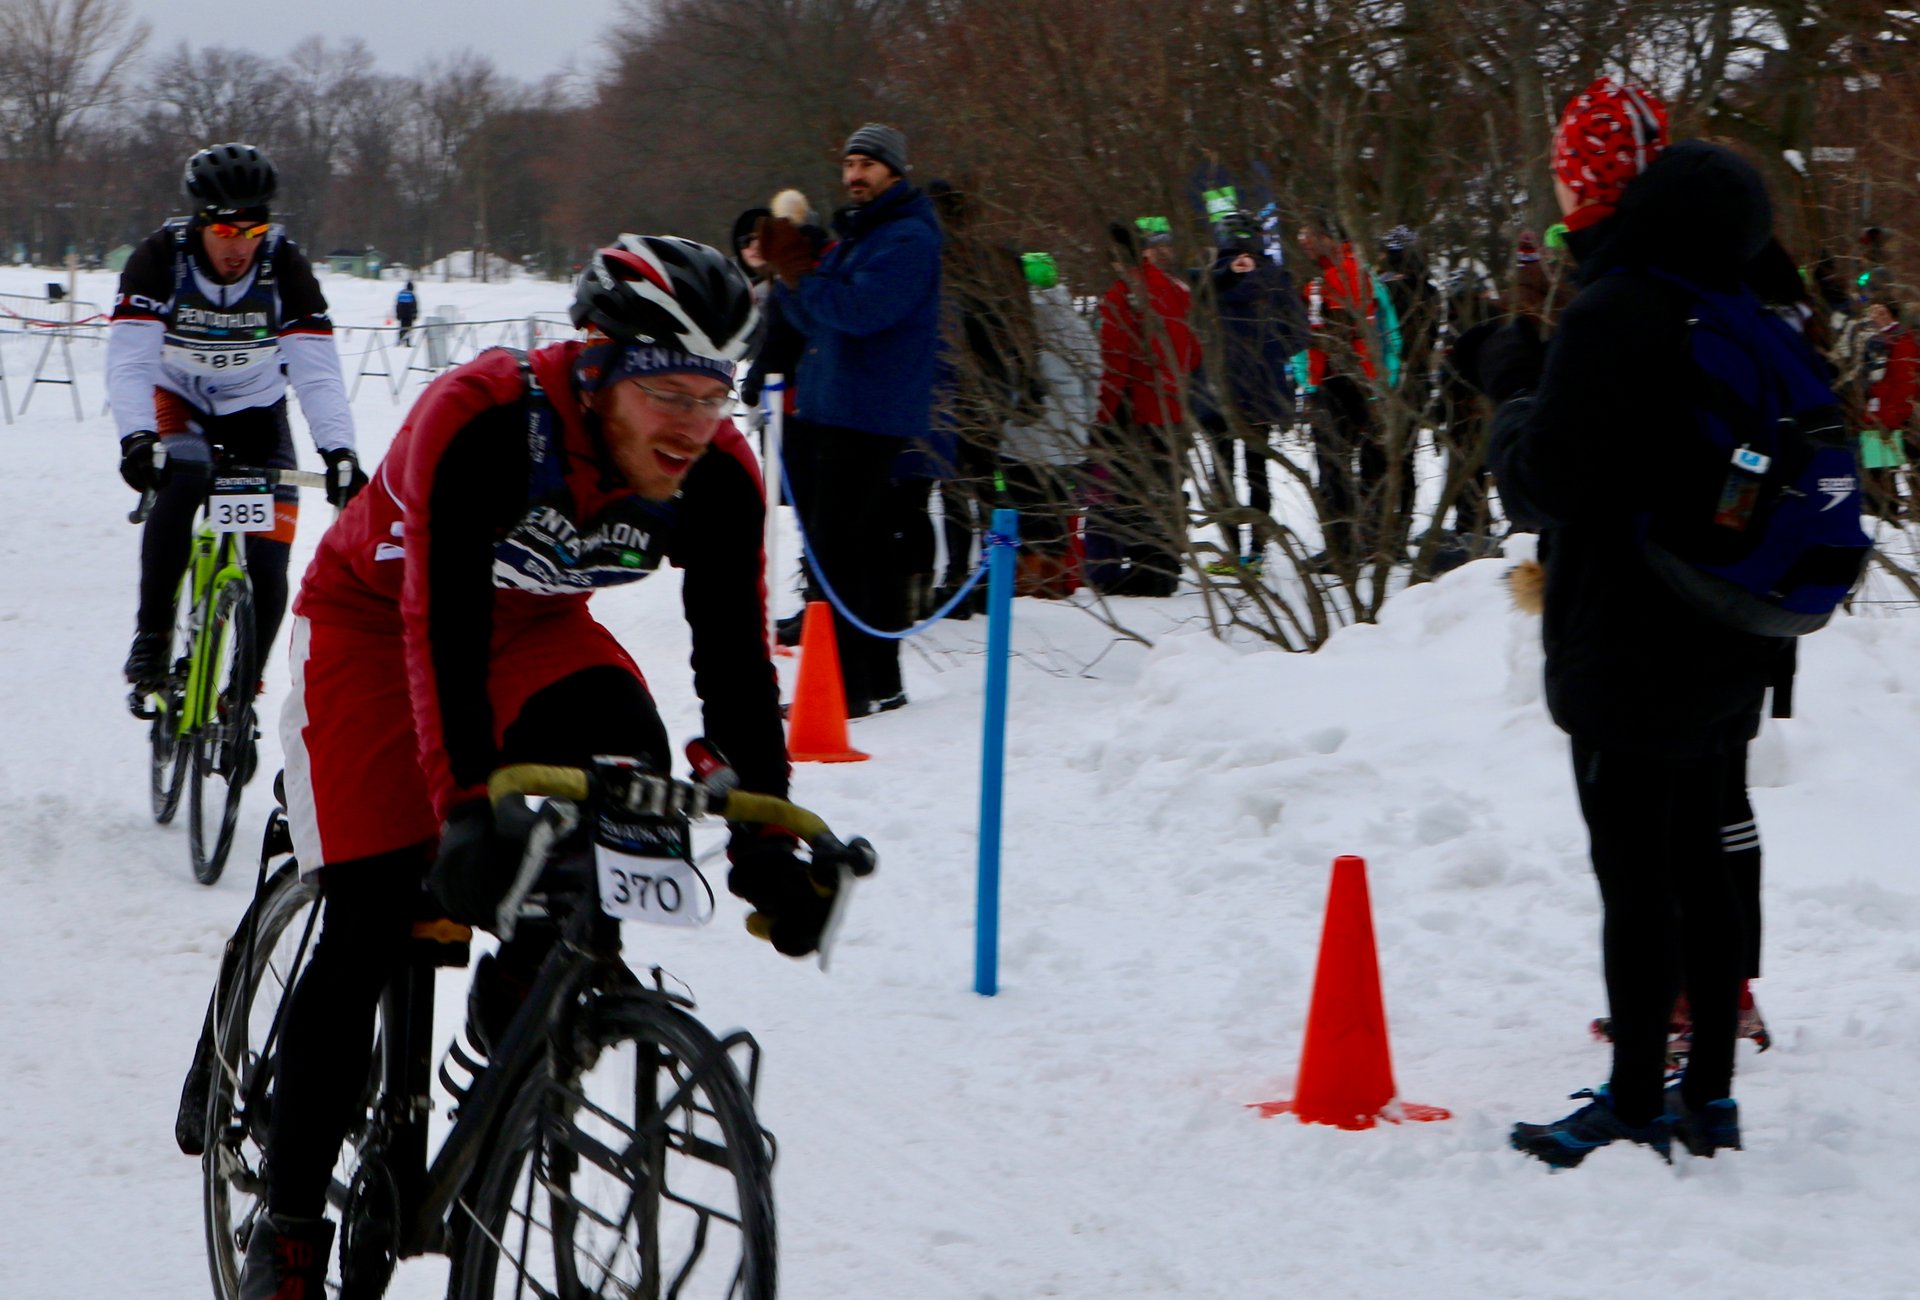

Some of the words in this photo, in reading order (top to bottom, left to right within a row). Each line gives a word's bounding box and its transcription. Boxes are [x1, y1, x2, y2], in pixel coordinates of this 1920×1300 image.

[177, 307, 268, 328] PENTATHLON
[219, 503, 266, 525] 385
[519, 505, 651, 559] ENTALON
[611, 867, 681, 912] 370
